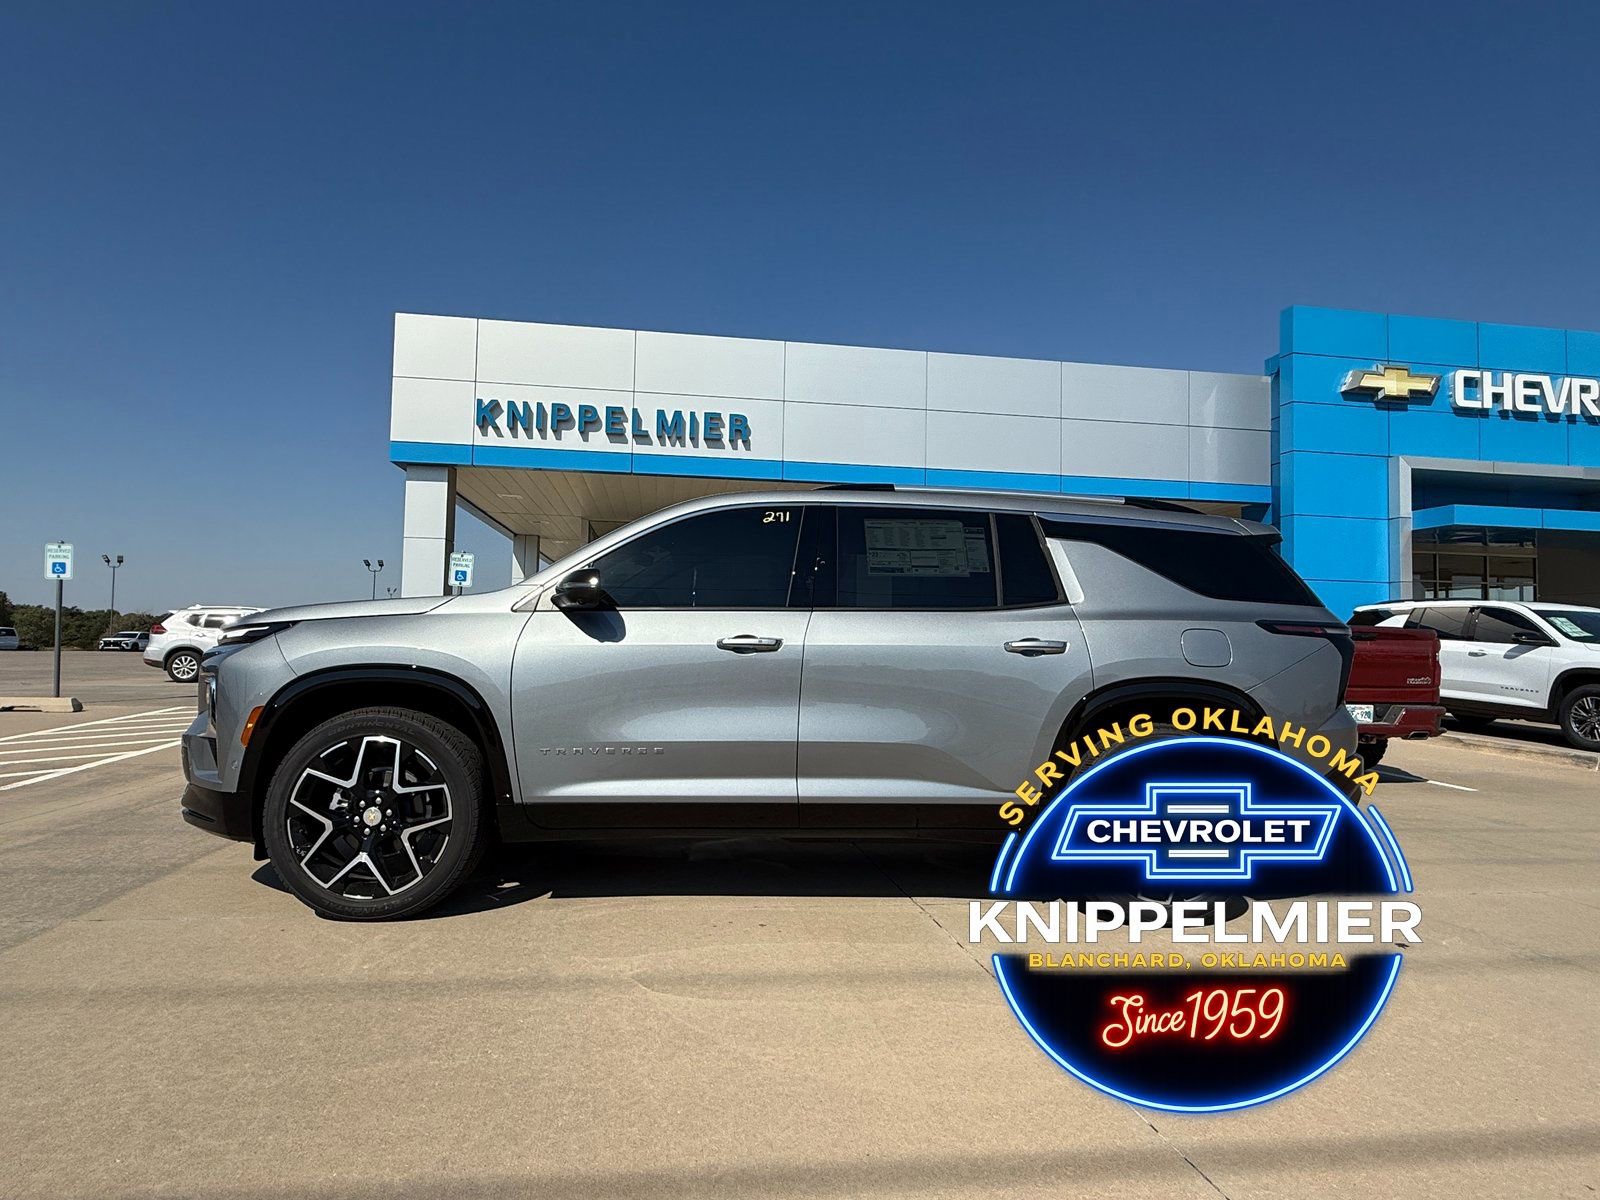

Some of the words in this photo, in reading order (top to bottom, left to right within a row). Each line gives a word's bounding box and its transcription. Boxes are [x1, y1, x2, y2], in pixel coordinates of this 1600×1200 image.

[1451, 369, 1600, 416] CHEVR
[476, 398, 751, 442] KNIPPELMIER
[540, 747, 664, 755] TRAVERSE
